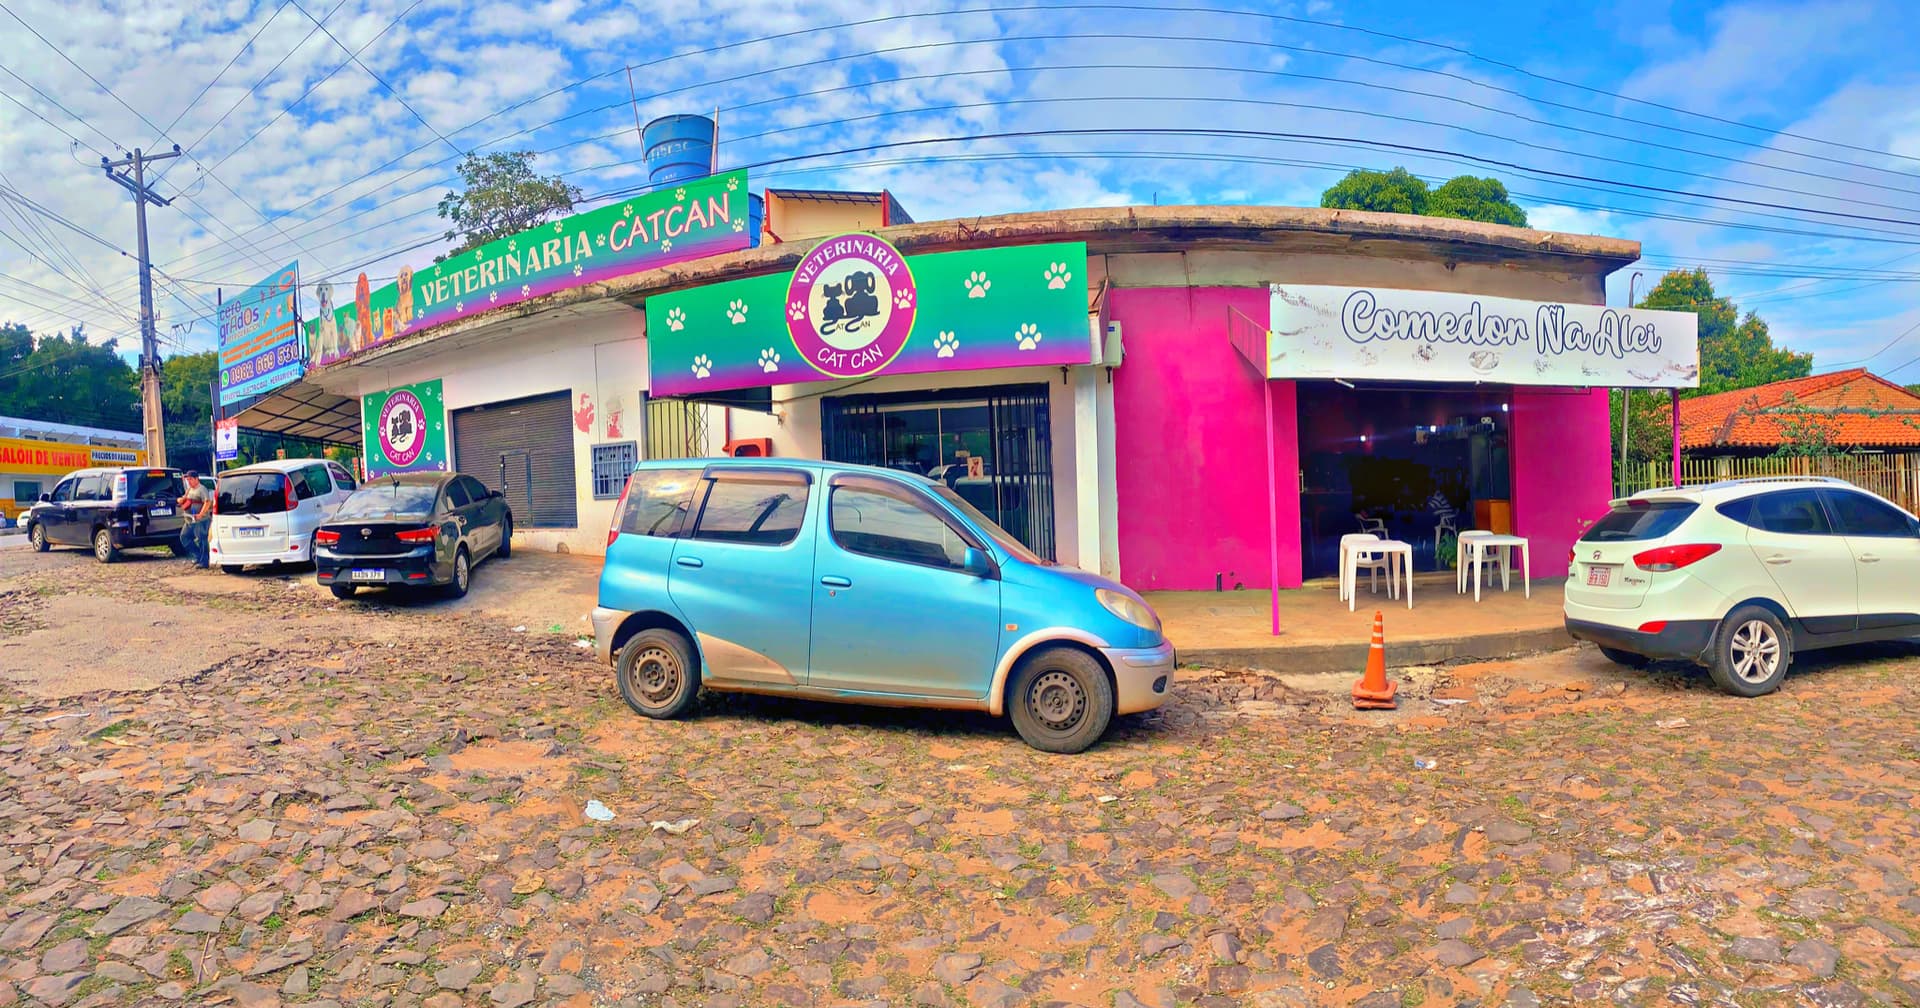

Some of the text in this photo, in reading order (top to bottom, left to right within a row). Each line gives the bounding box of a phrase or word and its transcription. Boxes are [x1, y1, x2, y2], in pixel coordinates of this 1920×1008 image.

[421, 191, 730, 306] VETERINARIA CATCAN
[798, 239, 899, 285] VETERINARIA
[1341, 290, 1662, 358] Comedor Ña Alci
[230, 360, 254, 385] 0982
[256, 351, 275, 374] 669
[817, 344, 884, 368] CAT CAN
[382, 393, 420, 418] VETERINARIA
[35, 449, 49, 465] DE
[51, 451, 88, 468] VENTAS
[389, 448, 415, 462] CAT CAN
